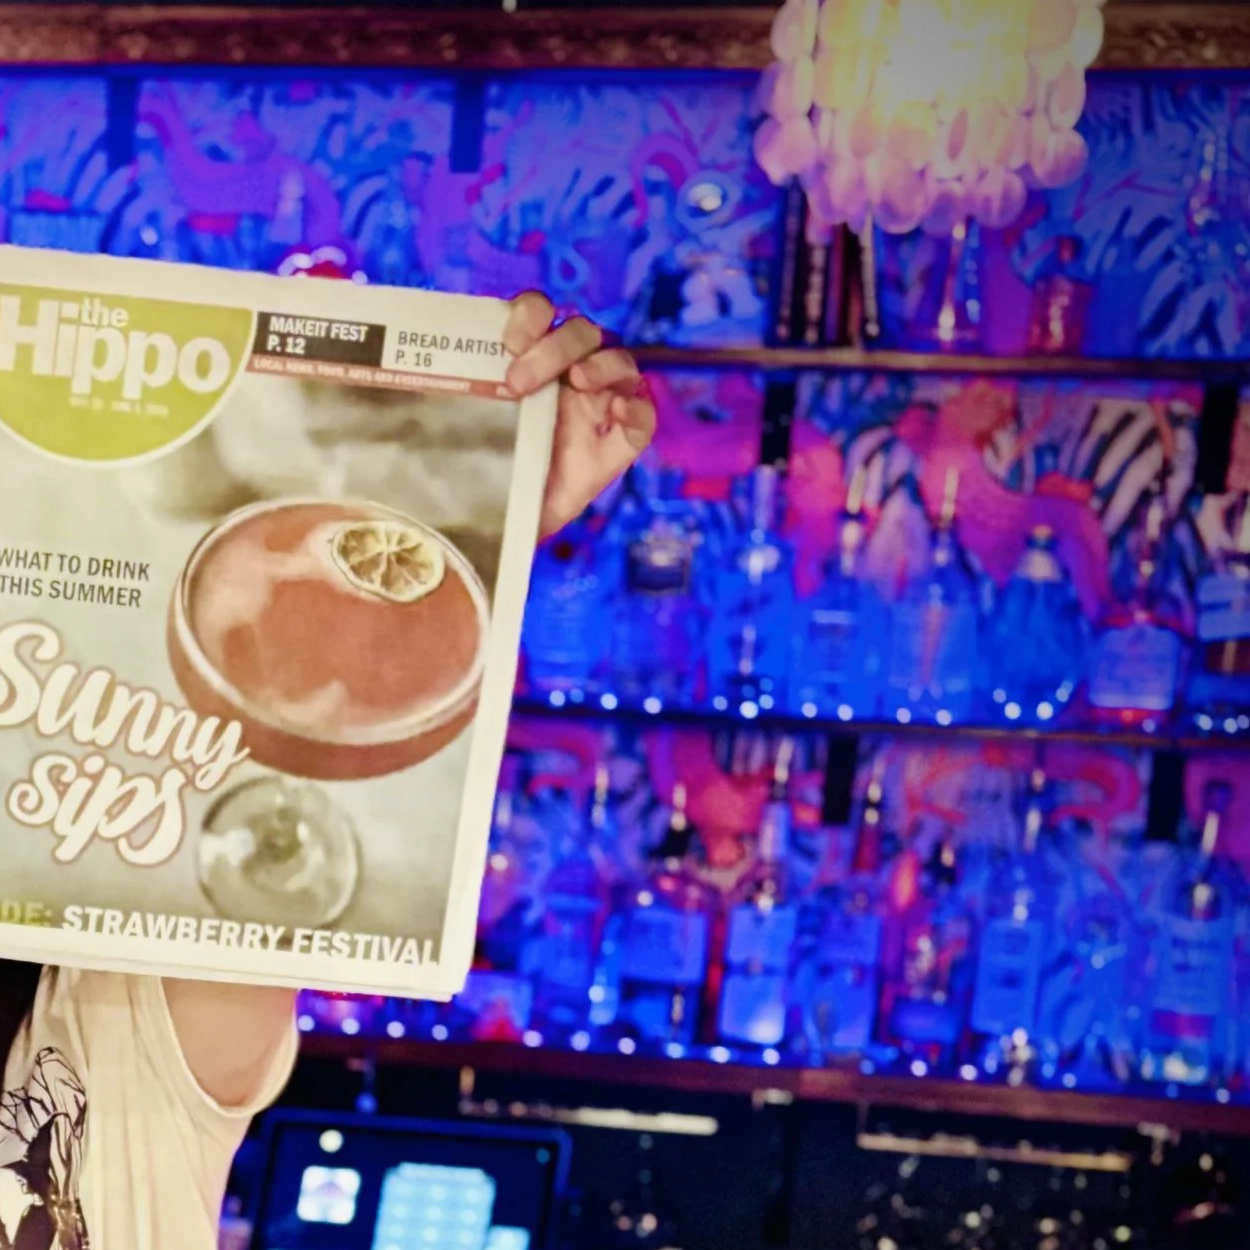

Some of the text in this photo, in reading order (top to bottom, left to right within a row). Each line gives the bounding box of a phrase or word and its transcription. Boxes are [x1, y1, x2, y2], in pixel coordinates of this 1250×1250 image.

[81, 297, 129, 328] the
[268, 315, 369, 343] MAKEIT FEST
[266, 334, 306, 355] P. 12
[395, 350, 433, 368] P. 16
[397, 331, 506, 358] BREAD ARTIST
[57, 553, 82, 575] TO
[87, 556, 150, 582] DRINK
[48, 579, 142, 609] SUMMER
[7, 752, 187, 867] sips
[61, 904, 286, 952] STRAWBERRY
[290, 927, 440, 967] FESTIVAL
